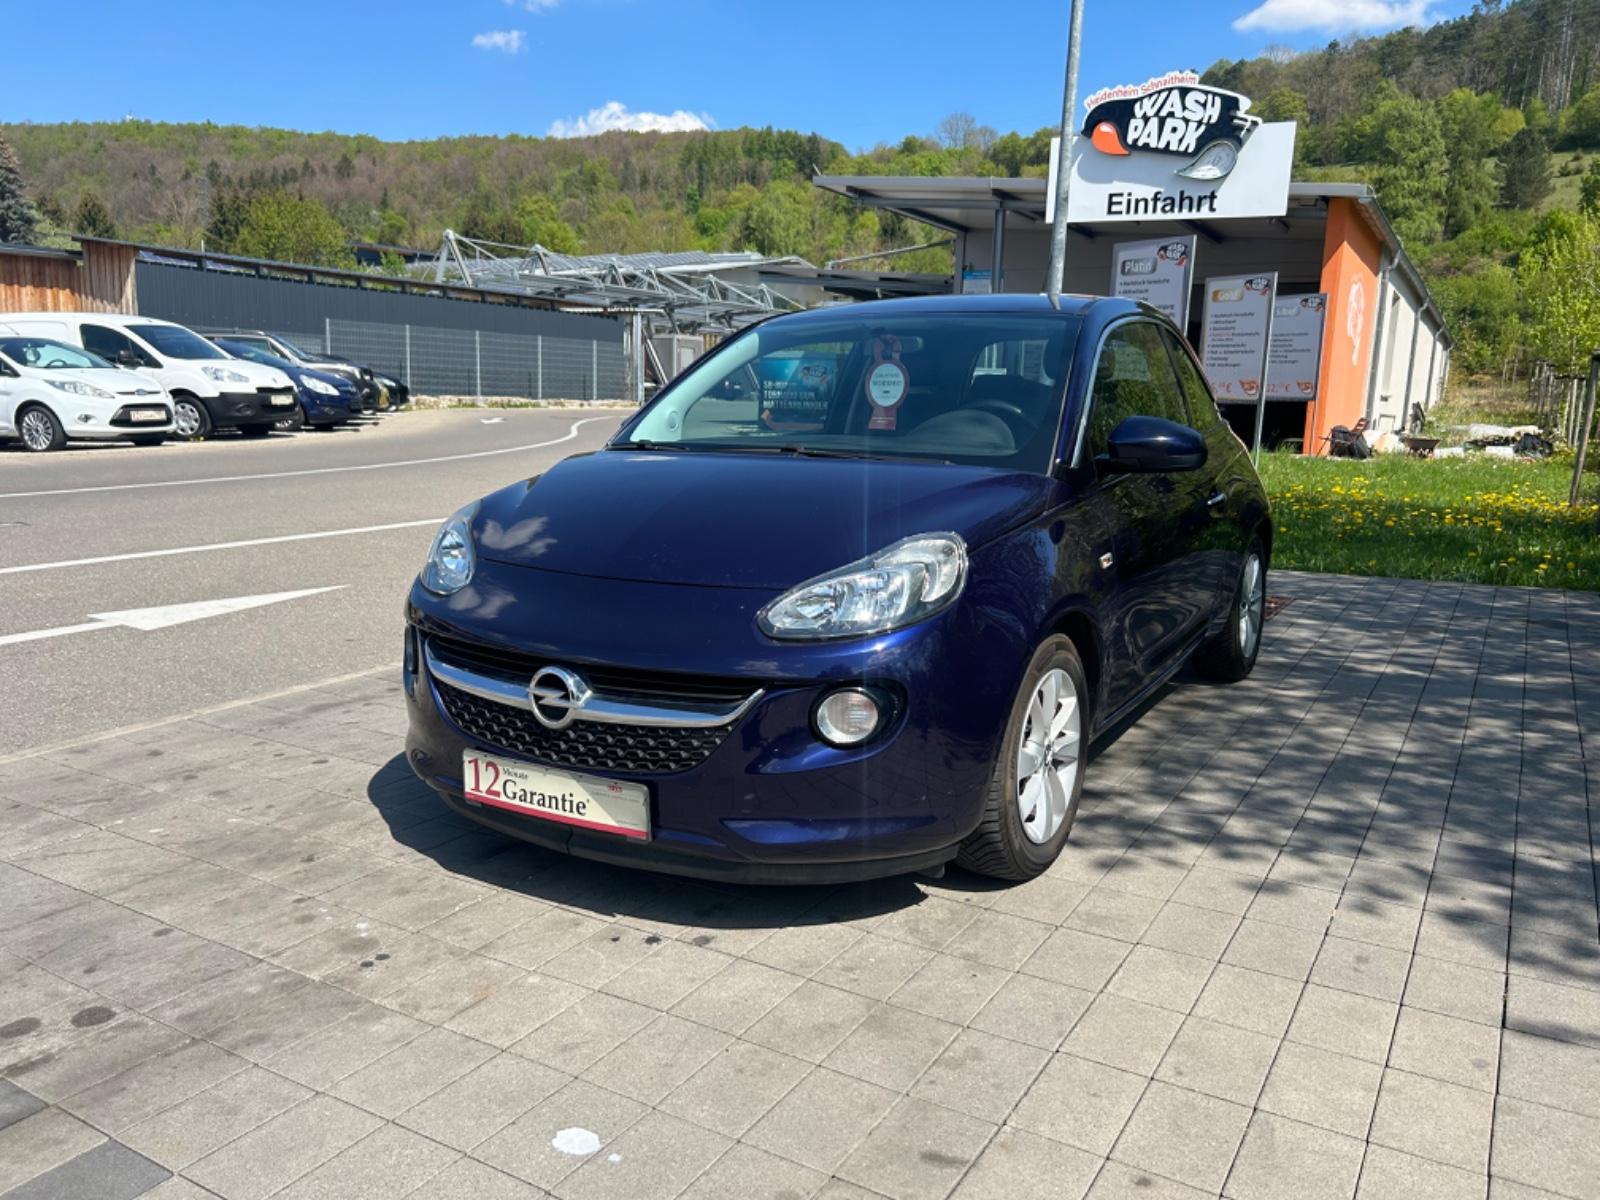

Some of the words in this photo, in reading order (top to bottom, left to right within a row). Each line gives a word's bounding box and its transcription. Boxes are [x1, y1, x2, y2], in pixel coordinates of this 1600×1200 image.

[1087, 87, 1139, 108] Heidenheim
[1140, 74, 1197, 93] Schnaitheim
[1133, 89, 1222, 124] WASH
[1126, 116, 1207, 153] PARK
[1106, 190, 1218, 216] Einfahrt
[468, 757, 501, 798] 12
[502, 779, 587, 816] Garantie
